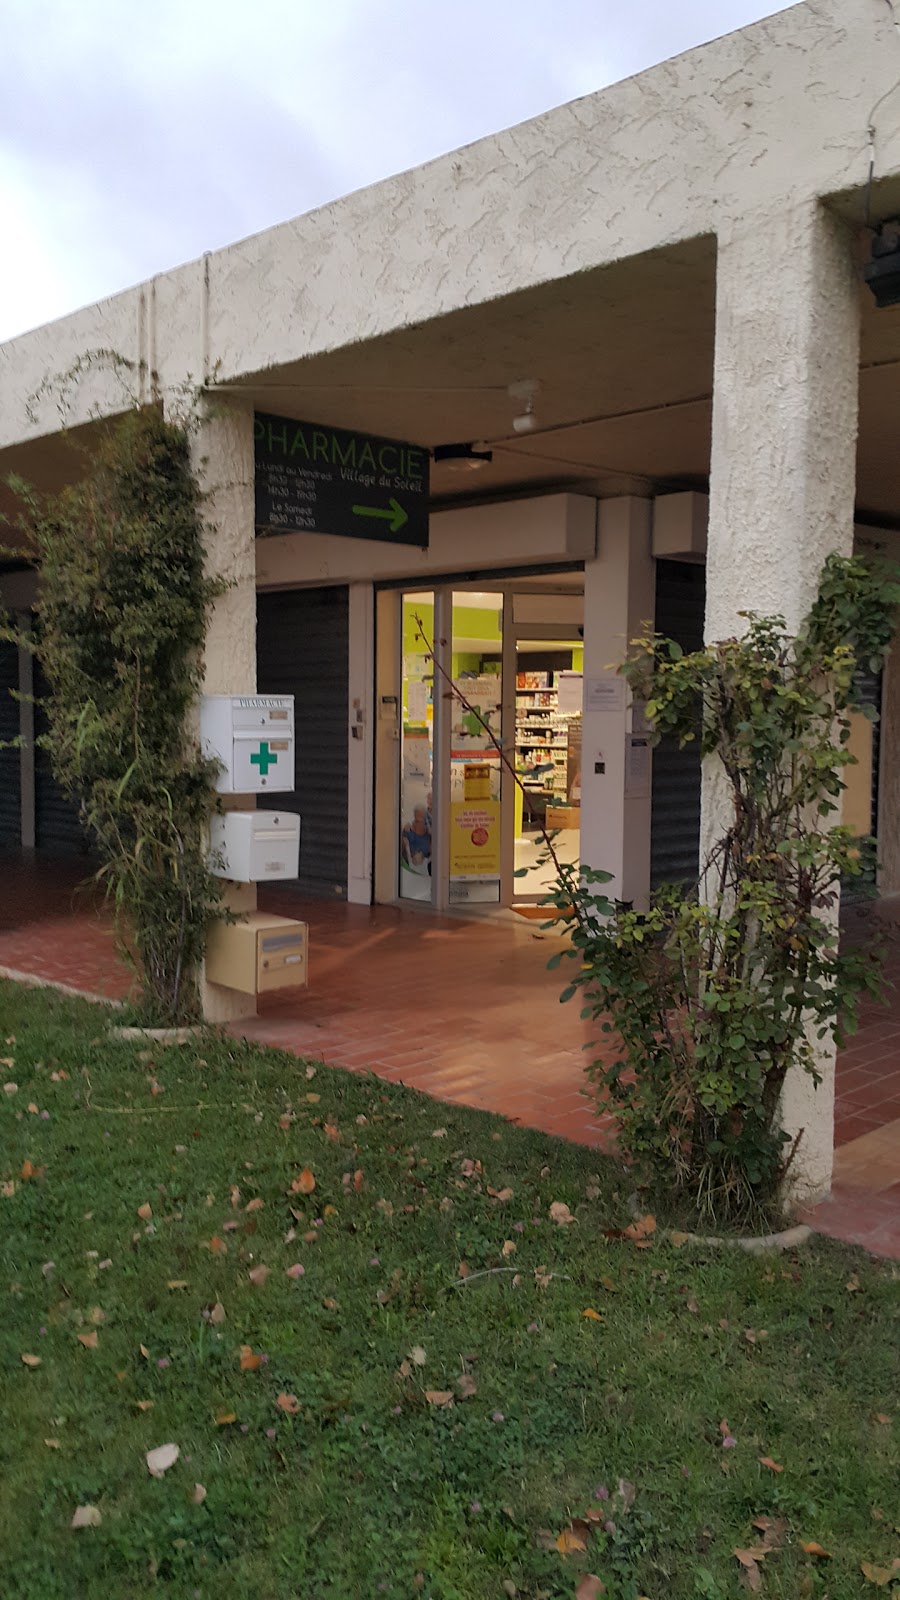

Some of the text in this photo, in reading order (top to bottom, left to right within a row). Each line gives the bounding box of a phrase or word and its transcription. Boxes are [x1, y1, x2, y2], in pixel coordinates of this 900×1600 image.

[254, 418, 424, 480] PHARMACIE
[340, 467, 423, 493] Village du Soleil
[284, 502, 313, 516] Samedi
